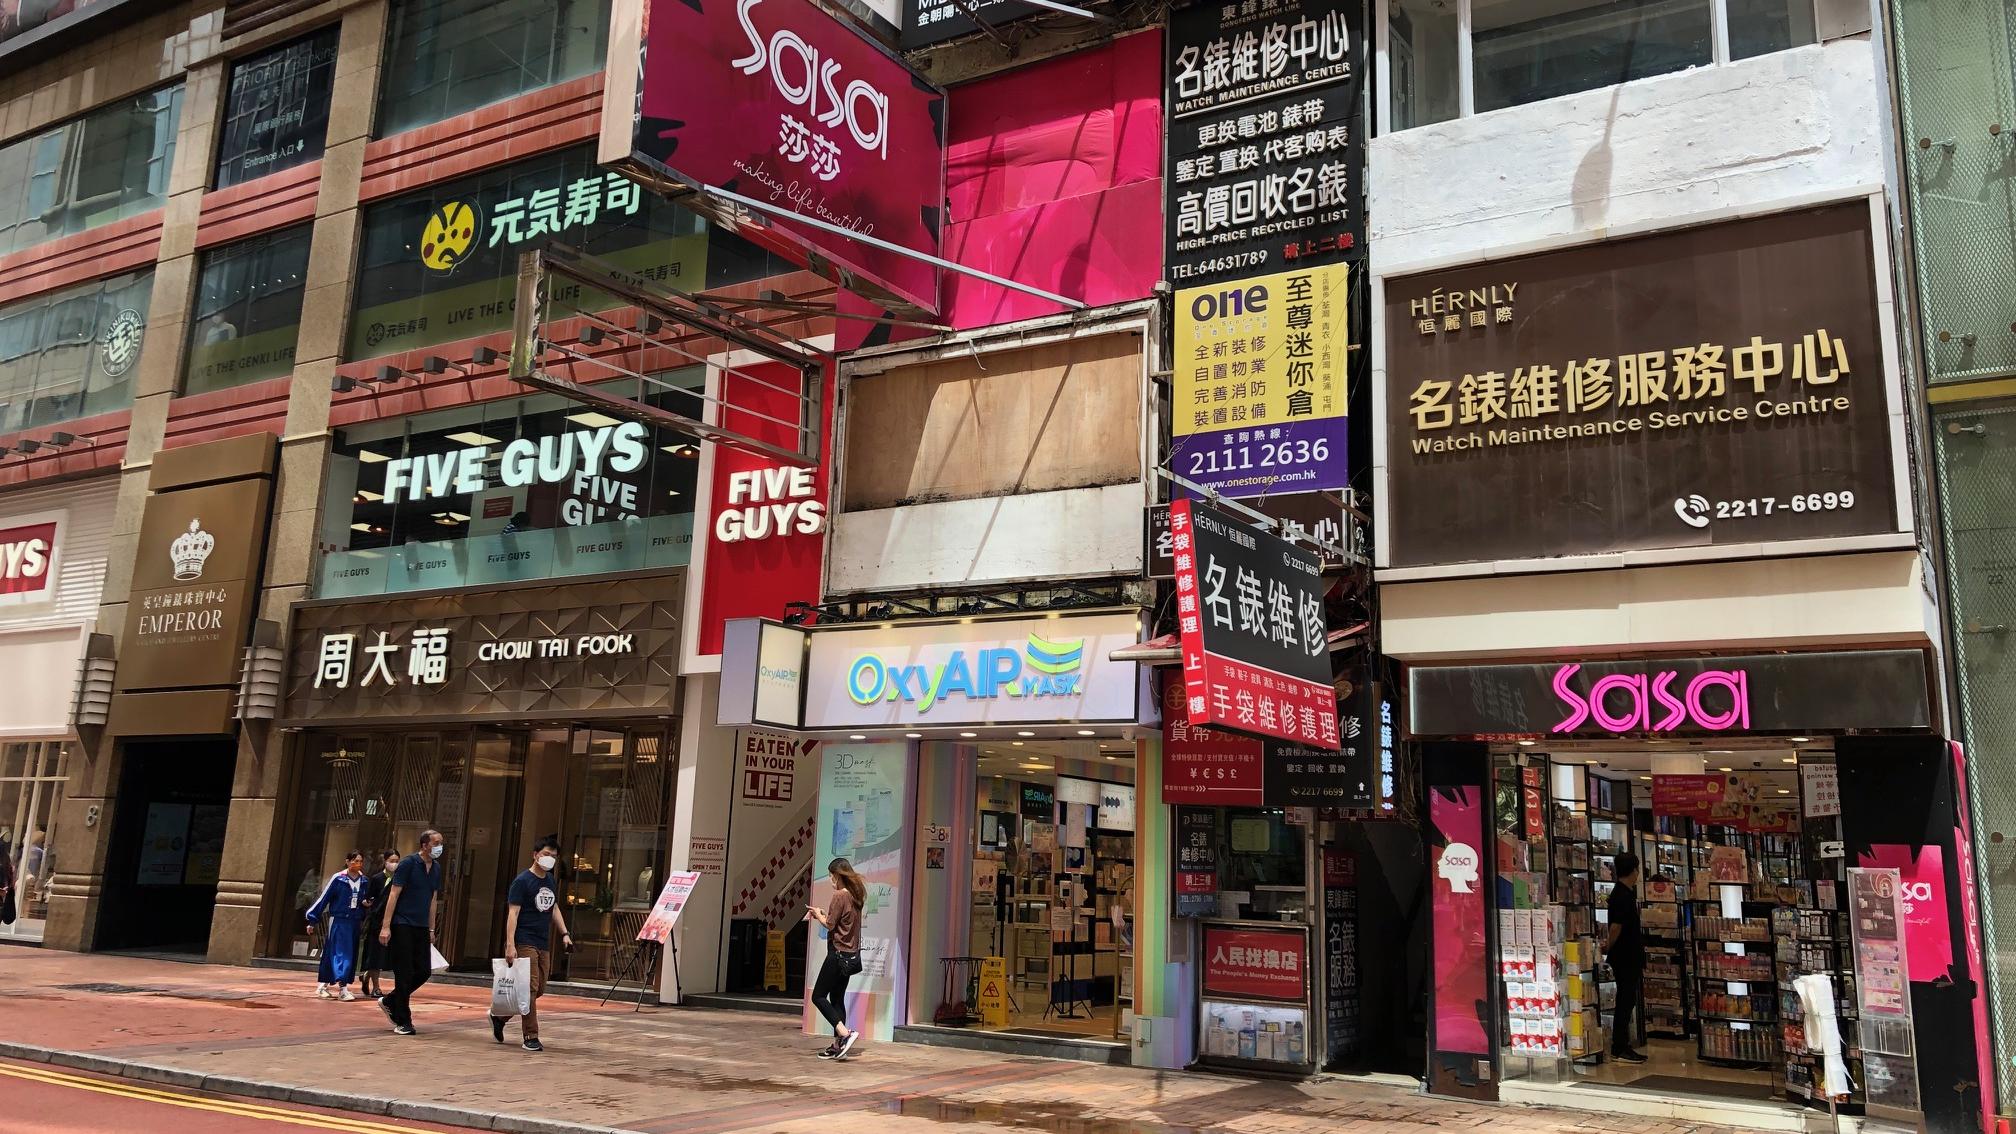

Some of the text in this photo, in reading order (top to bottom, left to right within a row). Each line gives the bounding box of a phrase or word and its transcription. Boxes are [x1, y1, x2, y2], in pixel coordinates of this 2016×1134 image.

[918, 0, 1004, 26] 金朝陽心二
[1220, 14, 1257, 29] DONGFENG
[1258, 7, 1283, 18] WATCH
[1175, 9, 1351, 98] 名錶維修中心
[1175, 62, 1351, 113] WATCH MAINTENANCE CENTER
[244, 145, 294, 169] Entrance 入口
[778, 113, 842, 181] 莎莎
[733, 159, 785, 201] making
[787, 180, 814, 214] life
[1176, 160, 1349, 237] 高價回收名錶
[489, 171, 641, 248] 元気寿司
[1176, 208, 1350, 252] HIGH-PRICE RECYCLED LIST
[1172, 249, 1269, 280] TEL:64631789
[448, 307, 474, 325] LIVE
[480, 300, 504, 317] THE
[554, 284, 581, 303] LIFE
[1410, 282, 1519, 316] HÉRNLY
[1194, 335, 1267, 361] 全新裝修
[1286, 274, 1315, 417] 至尊迷你倉
[216, 359, 235, 375] THE
[272, 346, 295, 362] LIFE
[1195, 358, 1266, 382] 自置物業
[1194, 380, 1266, 405] 完善消防
[1409, 328, 1851, 430] 名錶維修服務中心
[1194, 403, 1266, 427] 裝置設備
[1412, 394, 1851, 455] Watch Maintenance Service Centre
[383, 422, 650, 504] FIVE GUYS
[1189, 437, 1329, 475] 2111 2636
[573, 470, 638, 511] FIVE
[729, 465, 817, 504] FIVE
[1201, 469, 1316, 489] www.onestorage.com.hk
[1716, 490, 1855, 519] 2217-6699
[715, 500, 826, 543] GUYS
[1194, 511, 1228, 537] HÉRNLY
[577, 541, 623, 554] FIVE GUYS
[653, 536, 673, 547] FIVE
[425, 559, 447, 571] GUYS
[507, 551, 531, 562] GUYS
[1291, 556, 1319, 577] 2217 6699
[350, 567, 370, 578] GUYS
[1172, 512, 1207, 716] 手袋維修護理 上一樓
[1204, 553, 1326, 657] 名錶維修
[138, 609, 223, 636] EMPEROR
[314, 627, 450, 689] 周大福
[478, 633, 633, 662] CHOW TAI FOOK
[1022, 674, 1082, 698] MASK
[1213, 683, 1338, 744] 手袋維修護理
[747, 737, 796, 757] EATEN
[745, 755, 795, 771] IN YOUR
[1190, 767, 1238, 779] ¥ € $ £
[744, 773, 793, 799] LIFE
[1301, 788, 1344, 797] 2217 6699
[707, 843, 724, 851] GUYS
[1211, 946, 1298, 971] 人民找換店
[1222, 970, 1247, 978] People's
[1249, 971, 1269, 981] Money
[1270, 973, 1300, 983] Exchange
